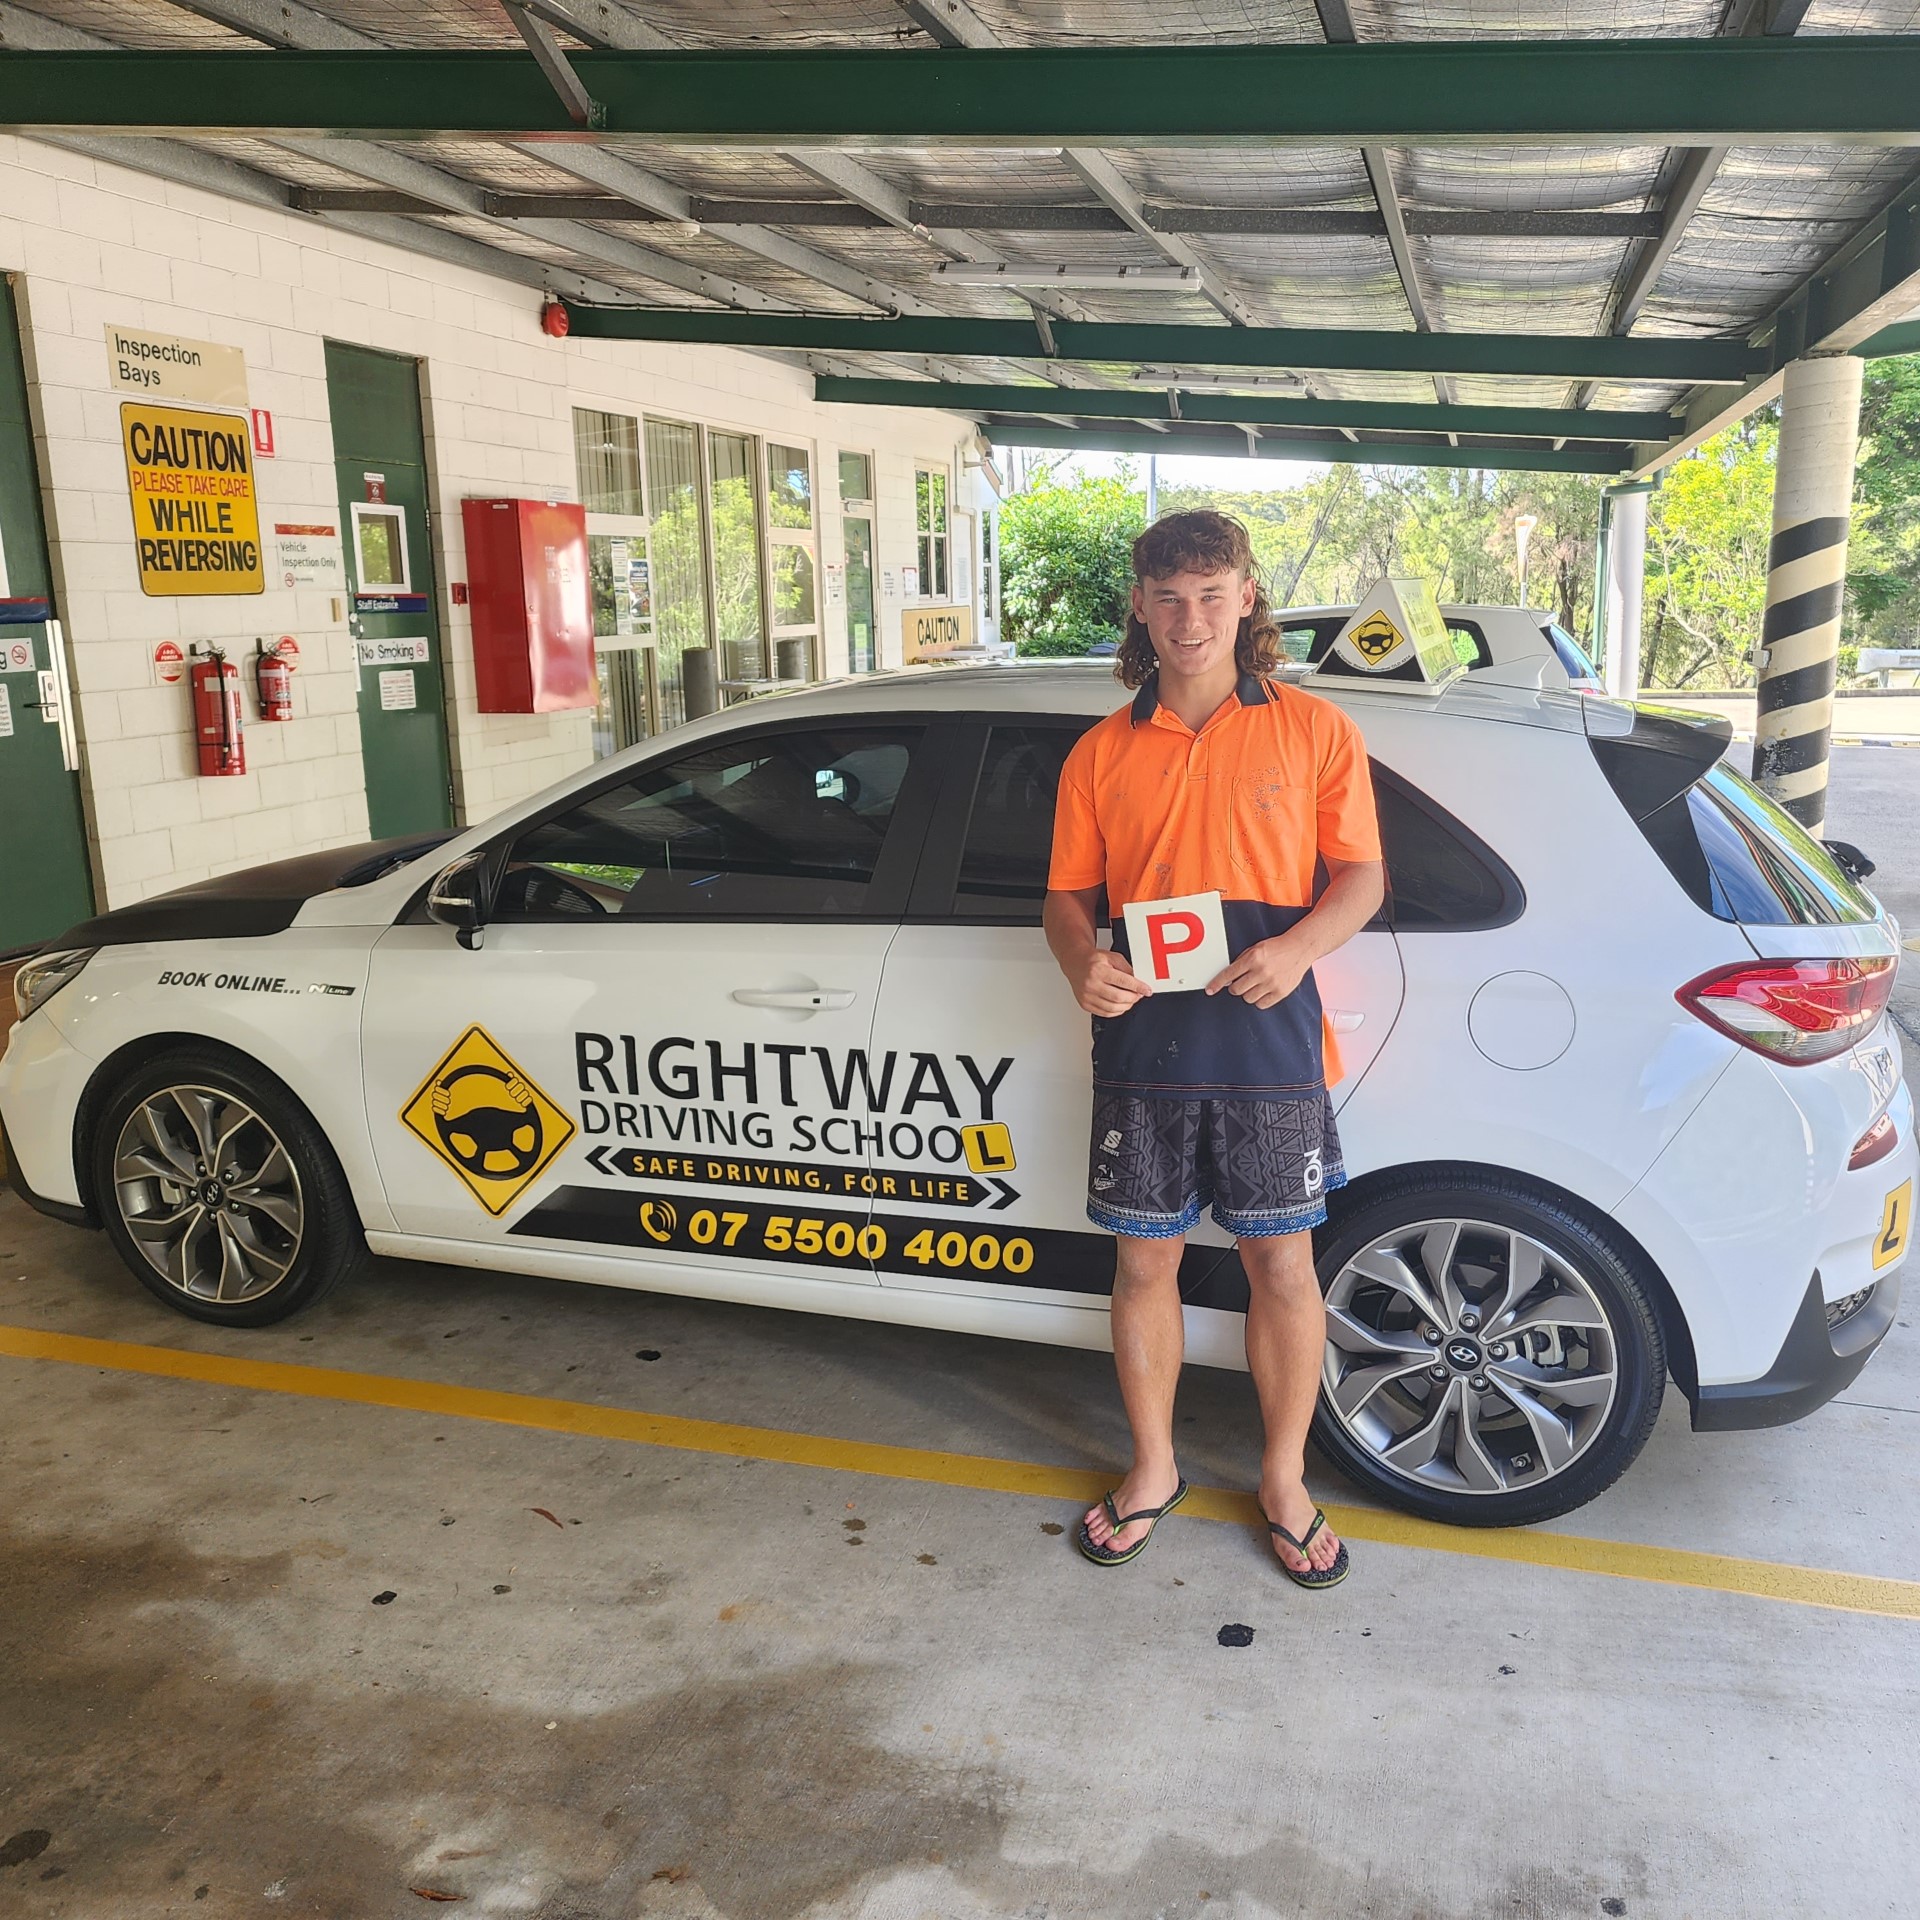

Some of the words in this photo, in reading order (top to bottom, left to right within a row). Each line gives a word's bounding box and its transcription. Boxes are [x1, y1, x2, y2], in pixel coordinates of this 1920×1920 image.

[115, 333, 201, 366] Inspection
[118, 360, 161, 387] Bays
[130, 422, 247, 473] CAUTION
[132, 470, 184, 493] PLEASE
[186, 475, 217, 495] TAKE
[219, 477, 249, 497] CARE
[148, 498, 234, 534] WHILE
[139, 538, 257, 571] REVERSING
[280, 541, 307, 552] Vehicle
[282, 556, 319, 569] Inspection
[320, 557, 336, 569] Only
[357, 599, 373, 610] Staff
[373, 600, 399, 610] Entrance
[917, 615, 959, 646] CAUTION
[361, 645, 374, 660] No
[378, 644, 414, 660] Smoking
[1146, 912, 1205, 980] P
[157, 970, 213, 988] BOOK
[214, 974, 301, 995] ONLINE...
[575, 1032, 1015, 1121] RIGHTWAY
[580, 1098, 774, 1150] DRIVING
[632, 1155, 696, 1178] SAFE
[707, 1161, 831, 1192] DRIVING,
[843, 1173, 897, 1196] FOR
[910, 1179, 970, 1201] LIFE
[688, 1209, 748, 1246] 07
[763, 1215, 887, 1260] 5500
[903, 1229, 1035, 1274] 4000
[1881, 1199, 1900, 1254] L
